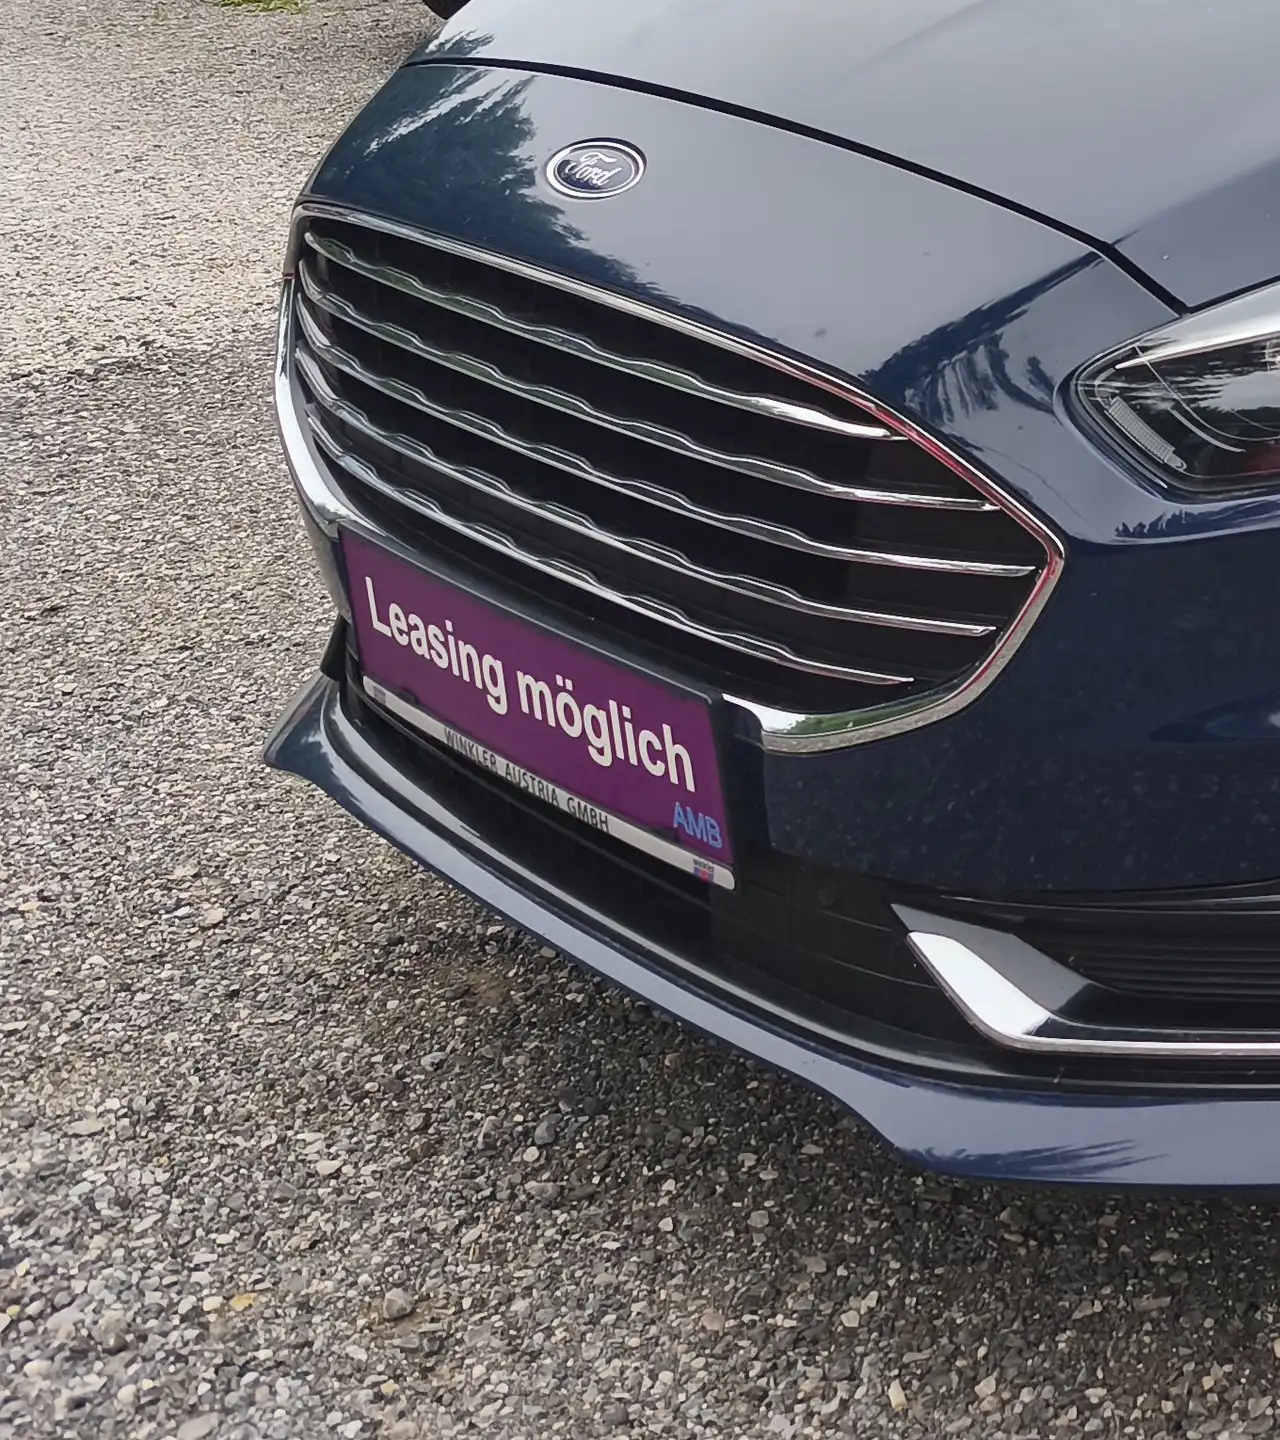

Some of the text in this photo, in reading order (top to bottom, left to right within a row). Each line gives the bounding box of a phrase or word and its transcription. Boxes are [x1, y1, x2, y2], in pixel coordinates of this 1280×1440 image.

[565, 151, 623, 186] Ford
[365, 576, 696, 793] Leasing möglich
[444, 726, 611, 834] WINKLER AUSTRIA GMBH
[673, 800, 723, 849] AMB
